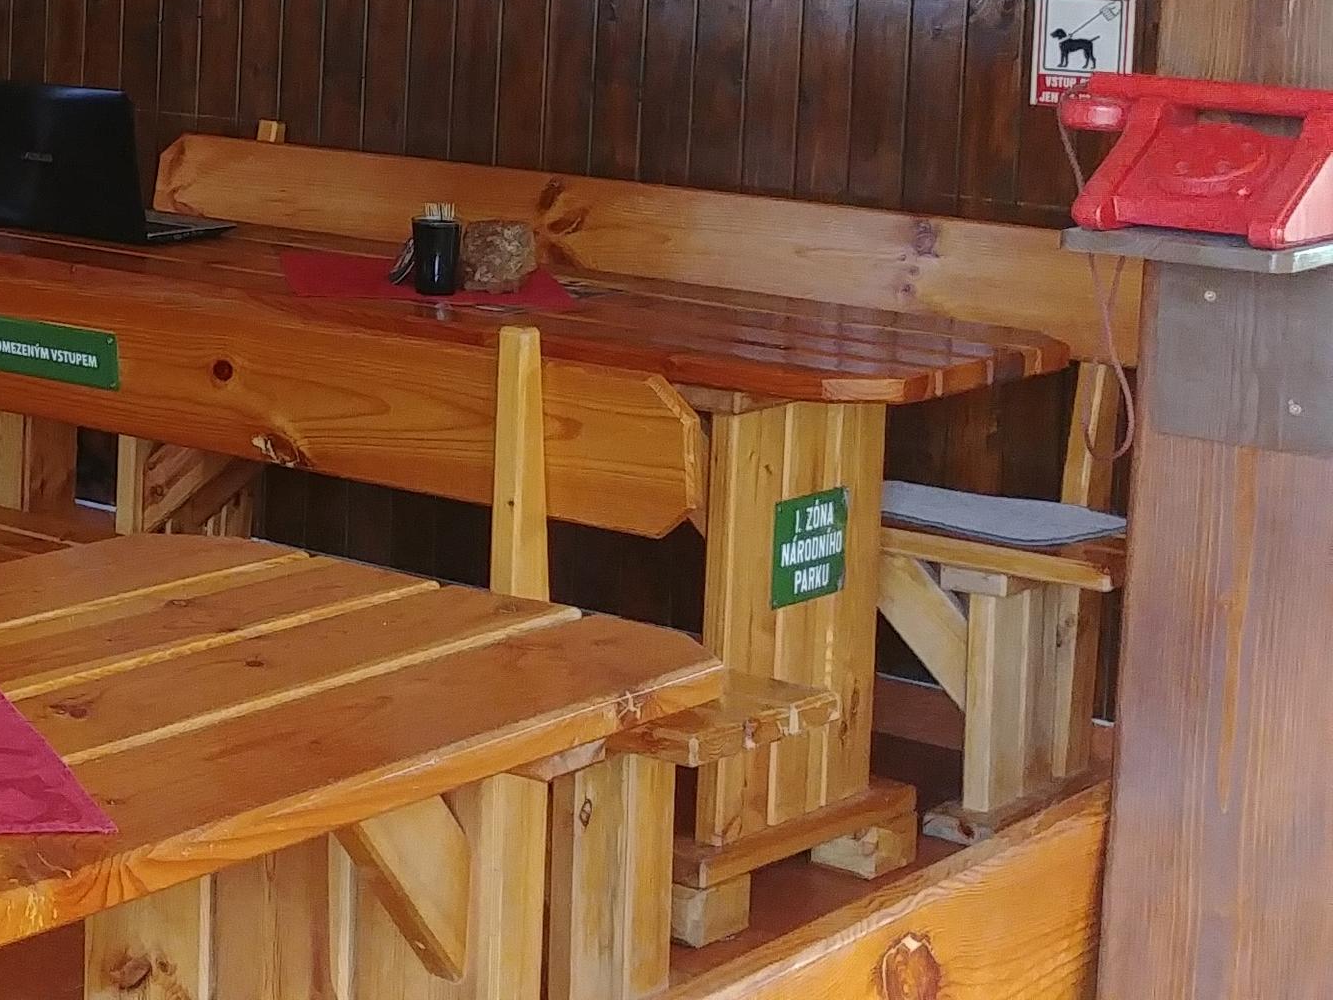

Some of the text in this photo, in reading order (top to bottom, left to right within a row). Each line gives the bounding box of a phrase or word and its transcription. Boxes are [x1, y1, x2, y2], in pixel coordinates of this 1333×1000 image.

[1045, 76, 1077, 89] VSTUP
[51, 348, 98, 369] VSTUPEM
[805, 499, 834, 532] ZÓNA
[780, 526, 843, 568] NÁRODNÍHO
[793, 562, 831, 595] PARKU
